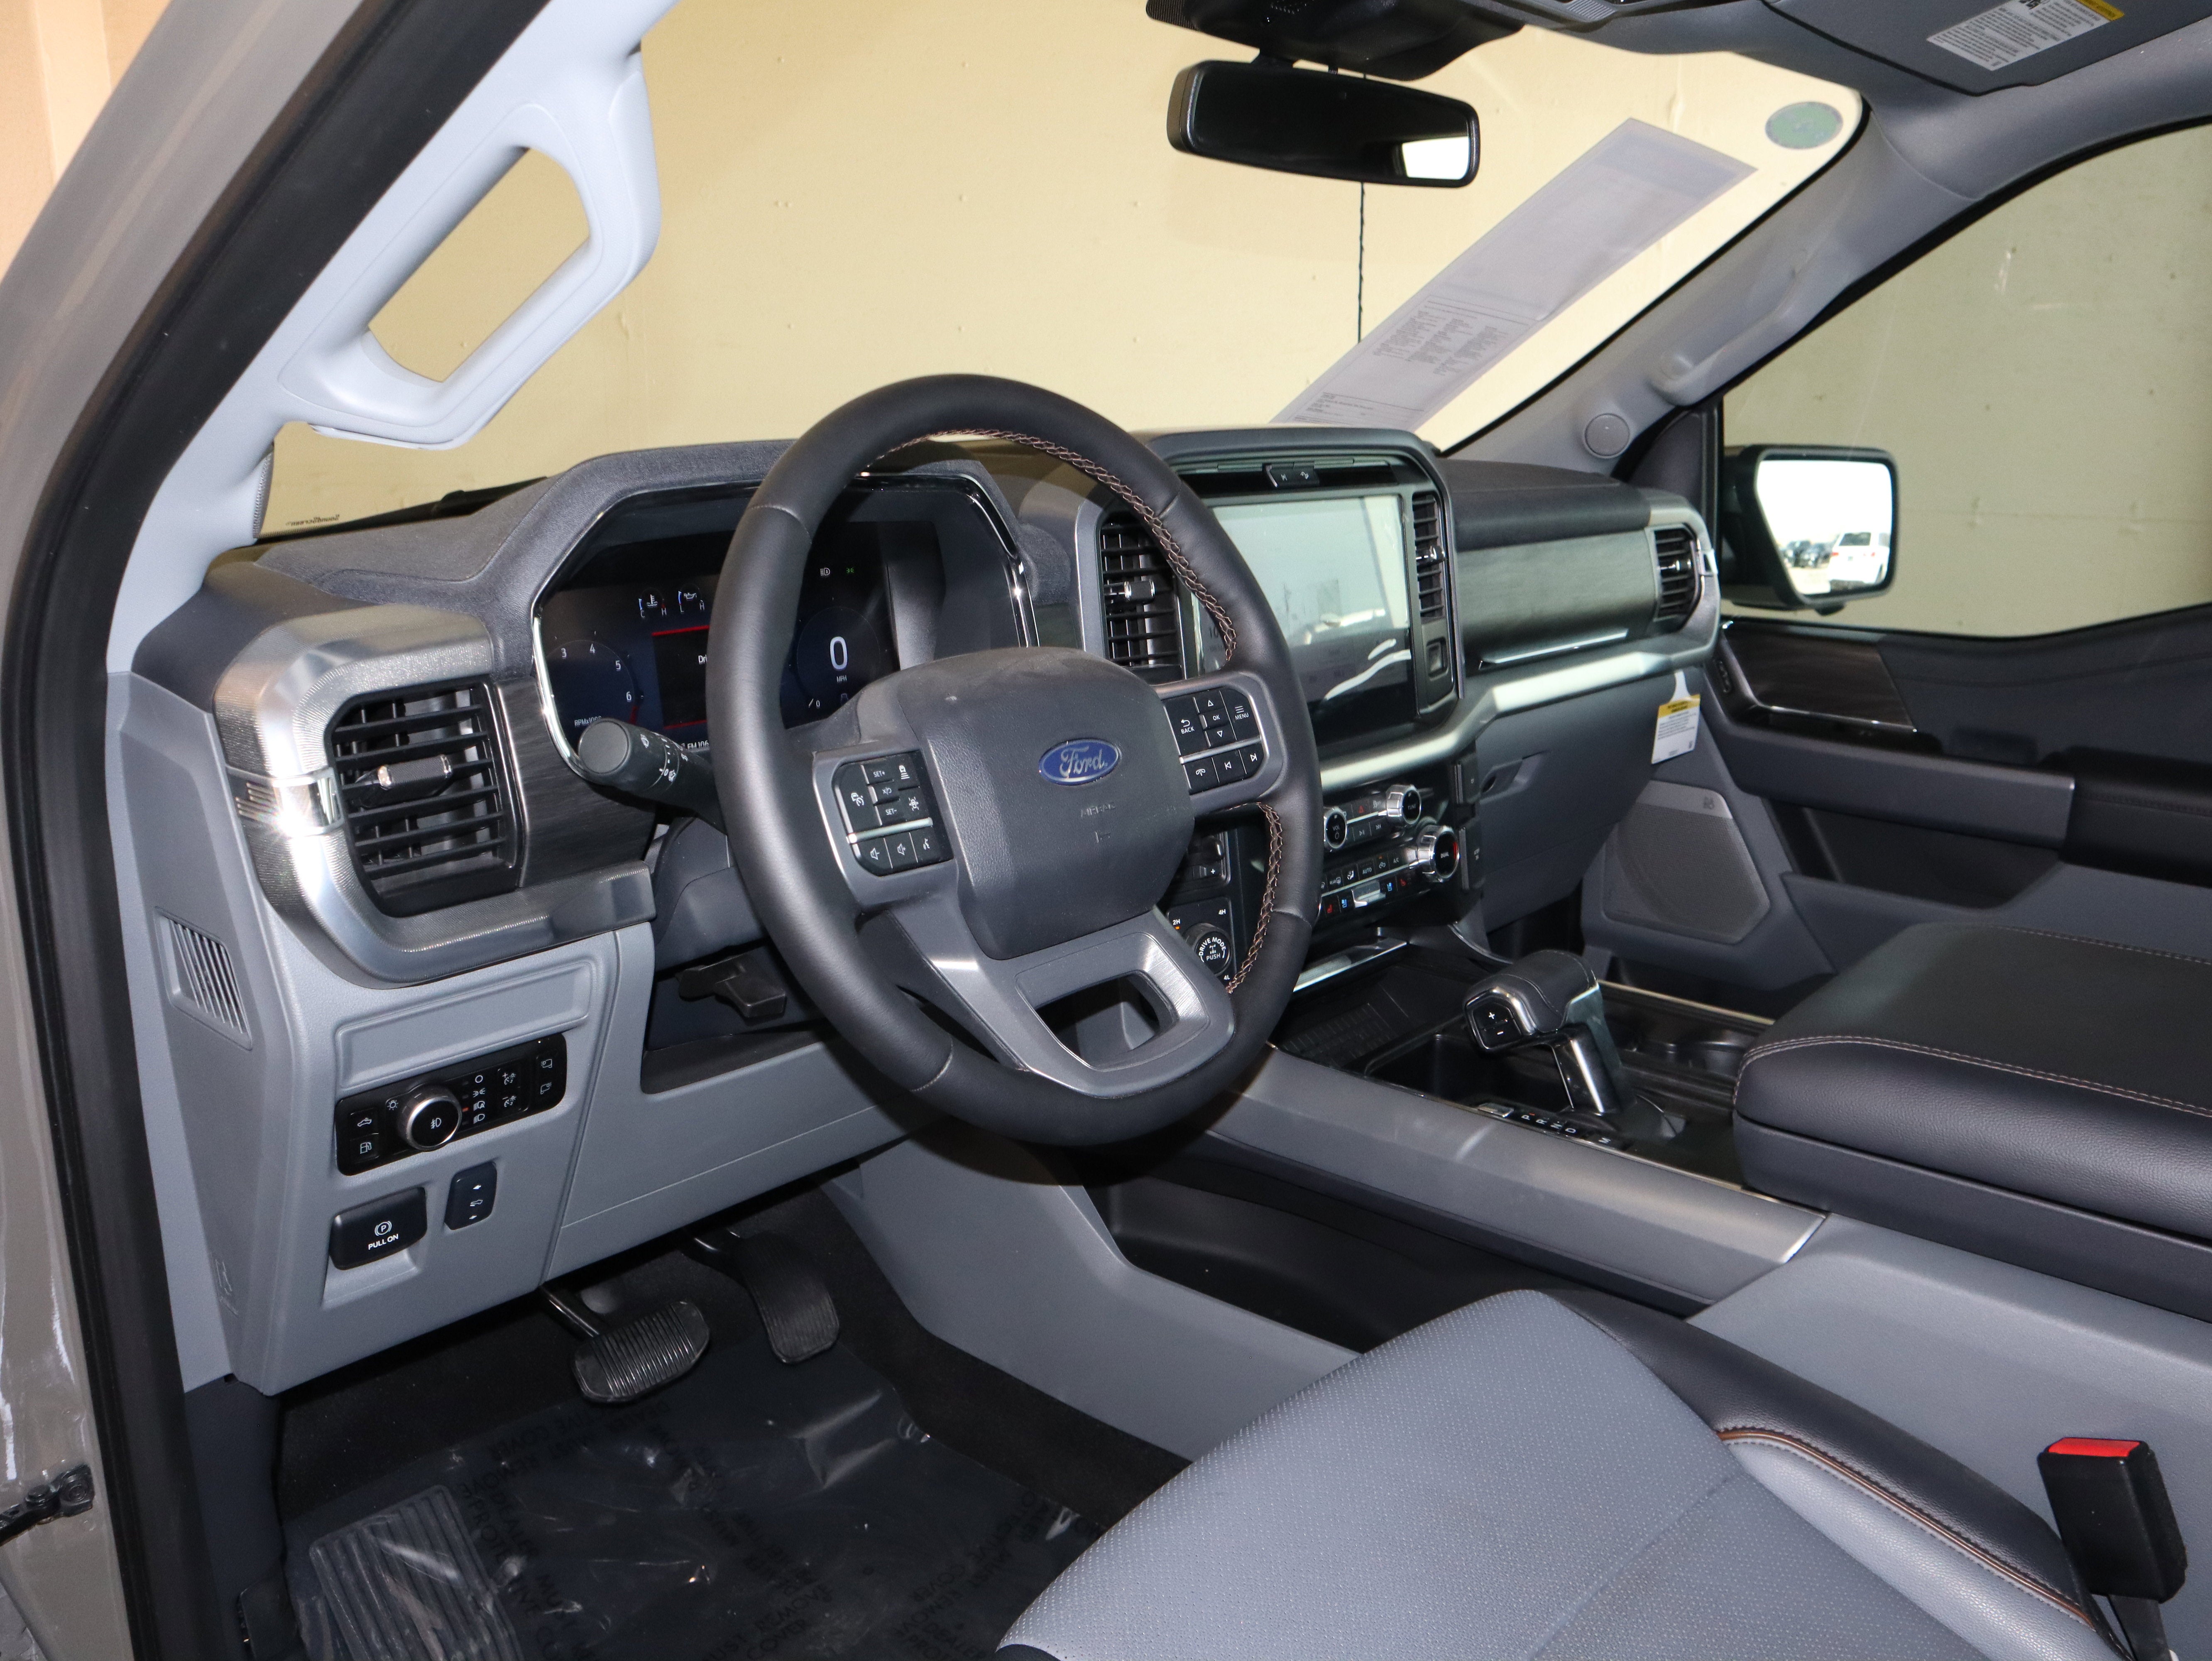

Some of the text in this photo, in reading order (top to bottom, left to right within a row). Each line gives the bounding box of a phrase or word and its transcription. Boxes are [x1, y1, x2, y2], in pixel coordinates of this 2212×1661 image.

[661, 608, 667, 616] H
[700, 602, 705, 611] H
[561, 648, 567, 659] 3
[589, 644, 596, 654] 4
[830, 636, 848, 671] 0
[615, 660, 621, 671] 5
[626, 691, 632, 702] 6
[1181, 726, 1195, 734] BACK
[1060, 746, 1105, 777] Ford
[1198, 936, 1227, 956] DRIVE MODE
[1206, 952, 1221, 961] PUSH
[368, 1233, 399, 1250] PULL ON
